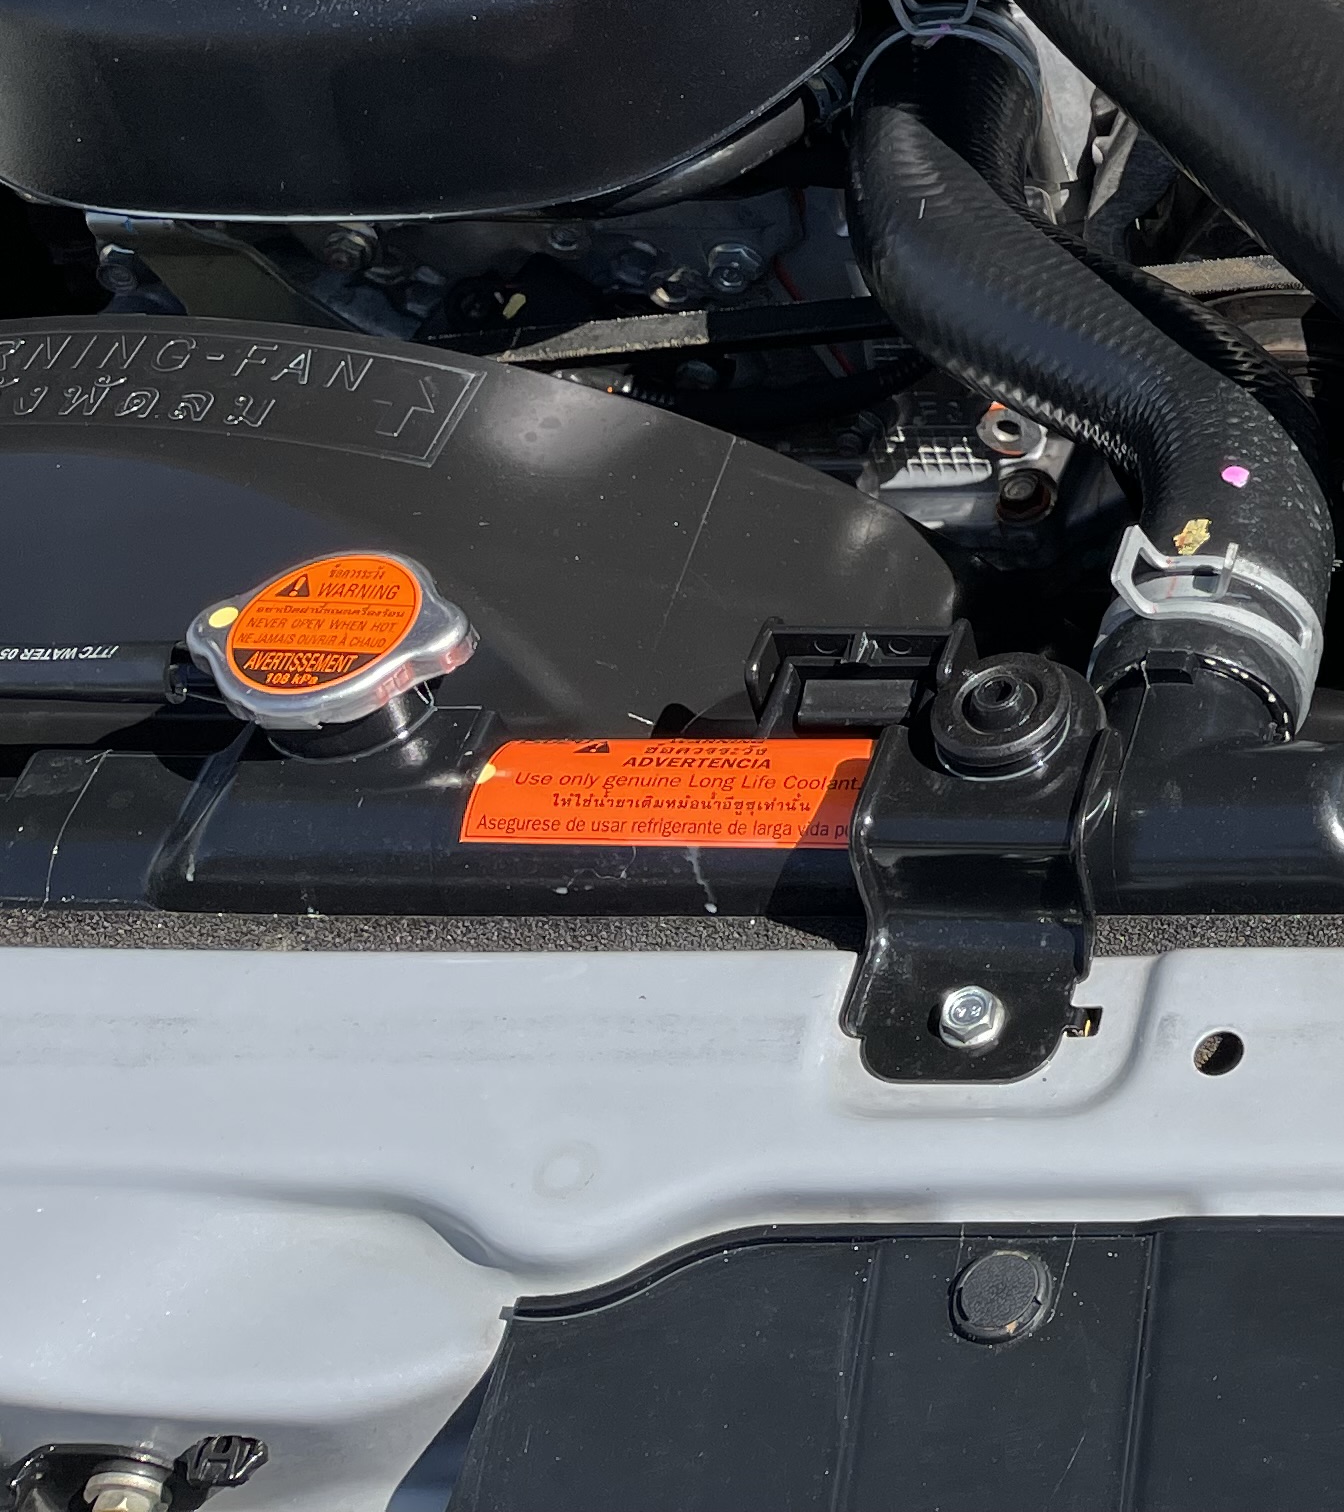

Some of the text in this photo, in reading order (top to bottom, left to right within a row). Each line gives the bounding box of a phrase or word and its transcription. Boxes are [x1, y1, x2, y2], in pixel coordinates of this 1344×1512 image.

[317, 583, 400, 600] WARNING
[246, 617, 287, 629] NEVER
[291, 618, 323, 630] OPEN
[329, 619, 368, 632] WHEN
[237, 633, 255, 644] NE
[255, 633, 296, 645] JAMAIS
[299, 635, 338, 647] OUVRIR
[350, 637, 386, 648] CHAUD
[20, 648, 78, 660] WATER
[243, 651, 358, 673] AVERTISSEMENT
[265, 673, 319, 685] 108 kPa
[622, 757, 770, 769] ADVERTENCIA
[515, 772, 552, 786] Use
[559, 773, 600, 789] only
[602, 774, 682, 790] genuine
[689, 774, 737, 791] Long
[741, 775, 776, 789] Life
[476, 814, 561, 834] Asegurese
[566, 817, 586, 832] de
[591, 819, 627, 833] usar
[631, 818, 722, 838] refrigerante
[728, 820, 747, 835] de
[753, 821, 792, 839] larga
[798, 822, 828, 837] vida
